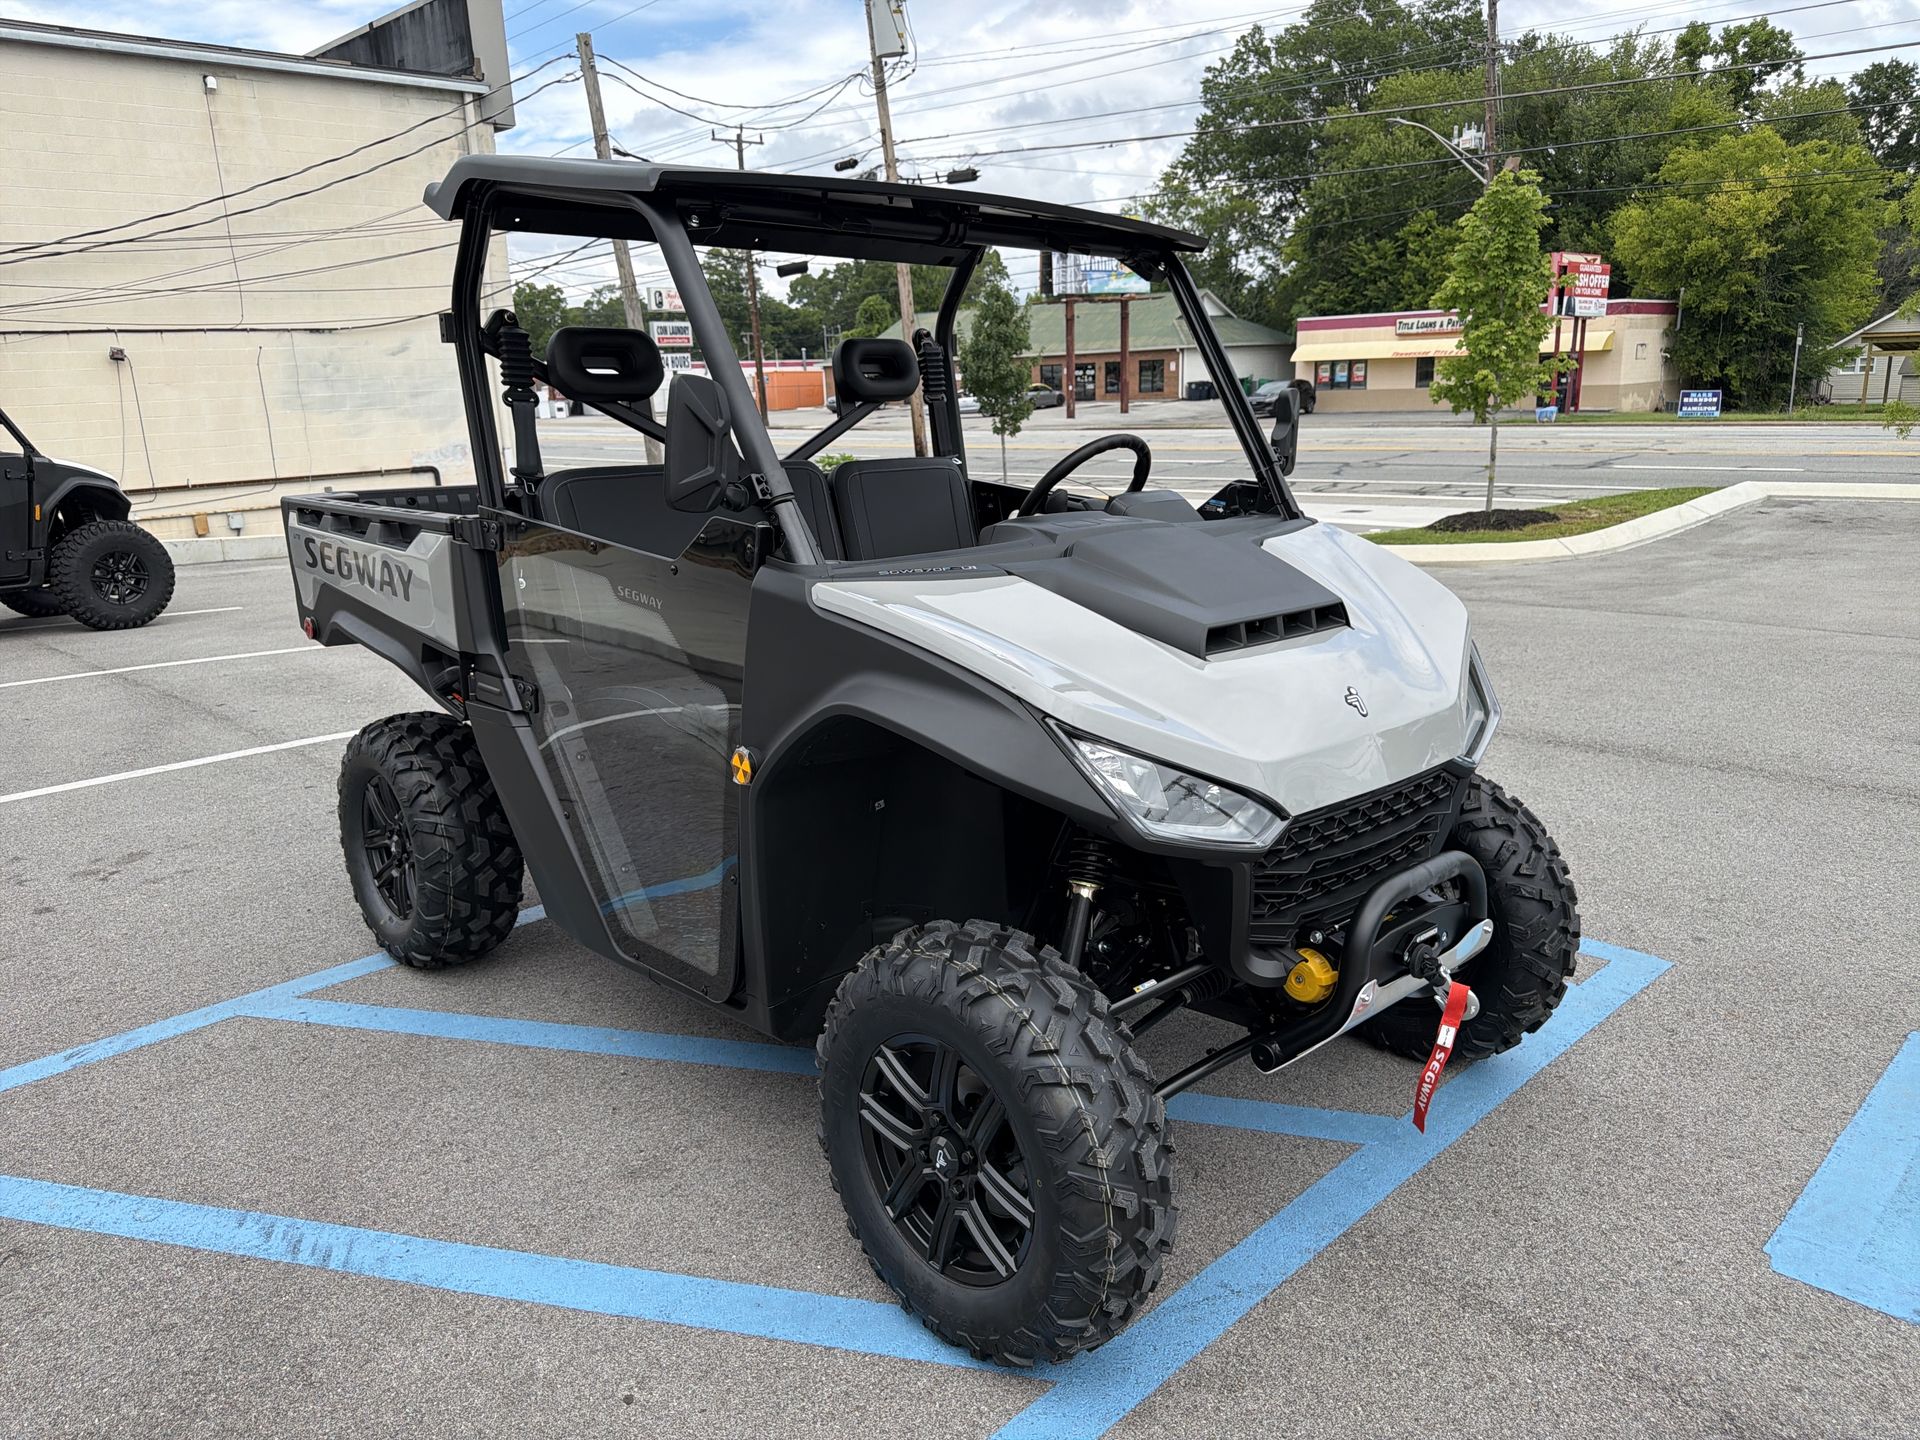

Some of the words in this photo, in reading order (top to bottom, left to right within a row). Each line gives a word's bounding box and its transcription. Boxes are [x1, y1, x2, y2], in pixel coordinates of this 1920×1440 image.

[1589, 274, 1610, 288] OFFER
[656, 325, 668, 336] COIN
[669, 325, 690, 336] LAUNDRY
[671, 356, 690, 368] HOURS
[304, 537, 413, 602] SEGWAY
[617, 585, 663, 610] SEGWAY
[1418, 1048, 1445, 1112] SEGWAY
